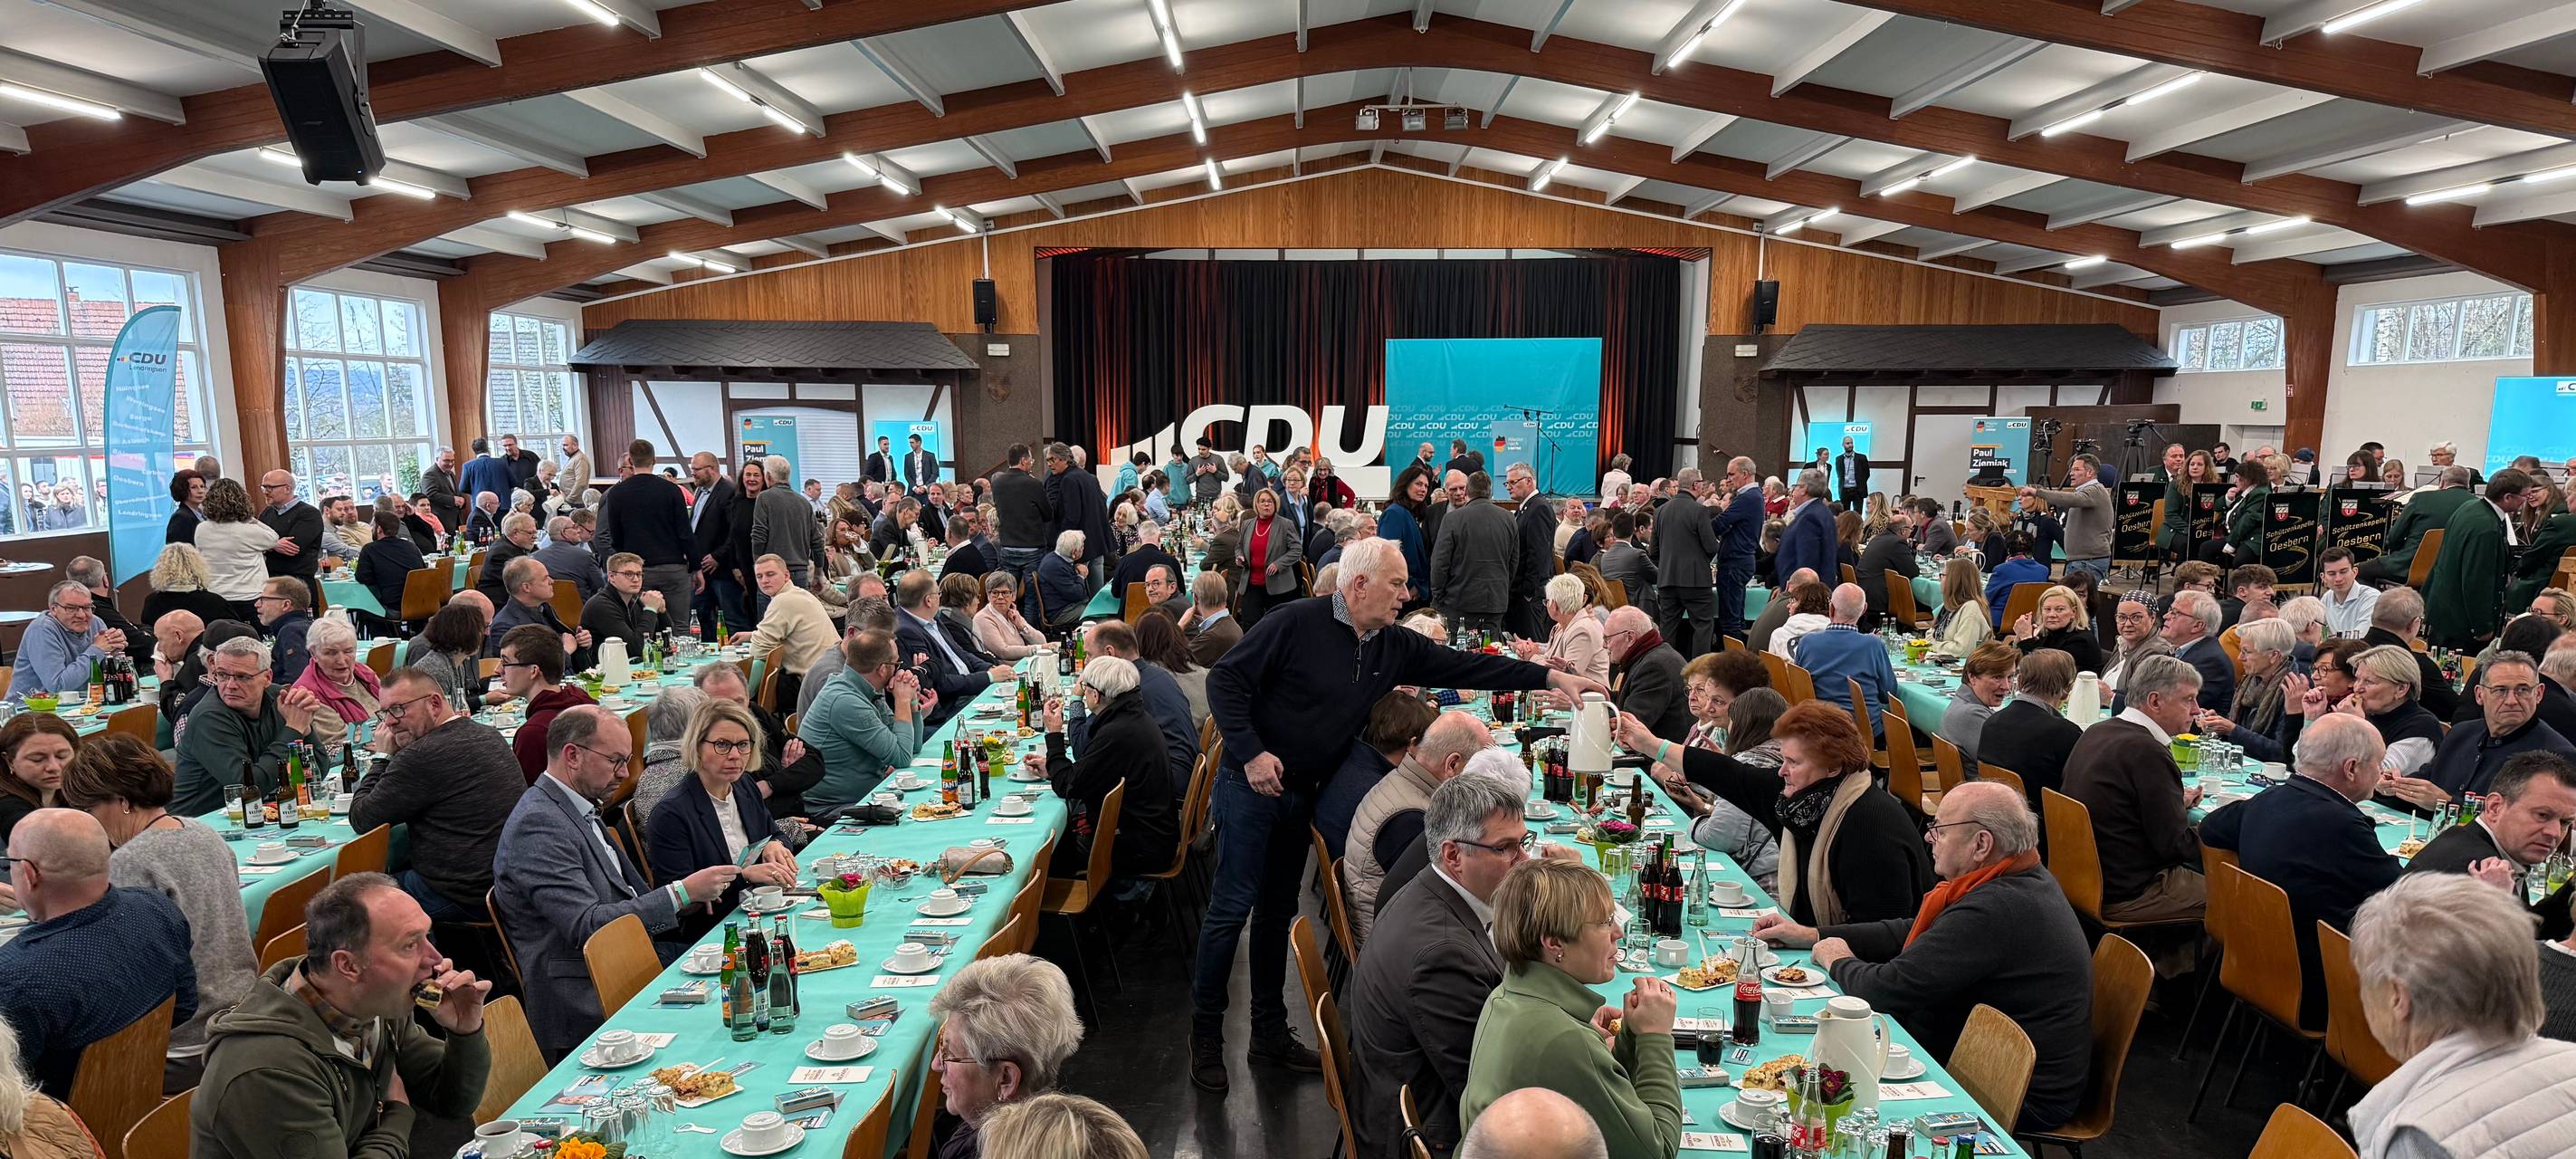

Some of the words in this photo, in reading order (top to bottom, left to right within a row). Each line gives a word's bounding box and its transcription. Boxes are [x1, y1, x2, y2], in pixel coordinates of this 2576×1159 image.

[129, 351, 167, 364] CDU
[1412, 413, 1434, 421] CDU
[1444, 413, 1465, 421] CDU
[1475, 413, 1498, 421] CDU
[1394, 422, 1416, 430] CDU
[1426, 422, 1447, 430] CDU
[1457, 422, 1479, 430] CDU
[1553, 421, 1575, 429] CDU
[1586, 421, 1598, 429] CD
[1179, 404, 1390, 467] CDU
[745, 445, 764, 453] Paul
[1973, 448, 1993, 457] Paul
[745, 455, 768, 463] Ziem
[1972, 459, 2008, 467] Ziemiak
[2118, 507, 2153, 522] Schützenkap
[2121, 520, 2151, 533] Oesber
[2266, 520, 2315, 539] Schützenkapelle
[2332, 516, 2388, 534] Schützenkapelle
[2269, 535, 2309, 552] Oesbern
[2336, 532, 2381, 549] Oesbern
[942, 781, 958, 789] FANT
